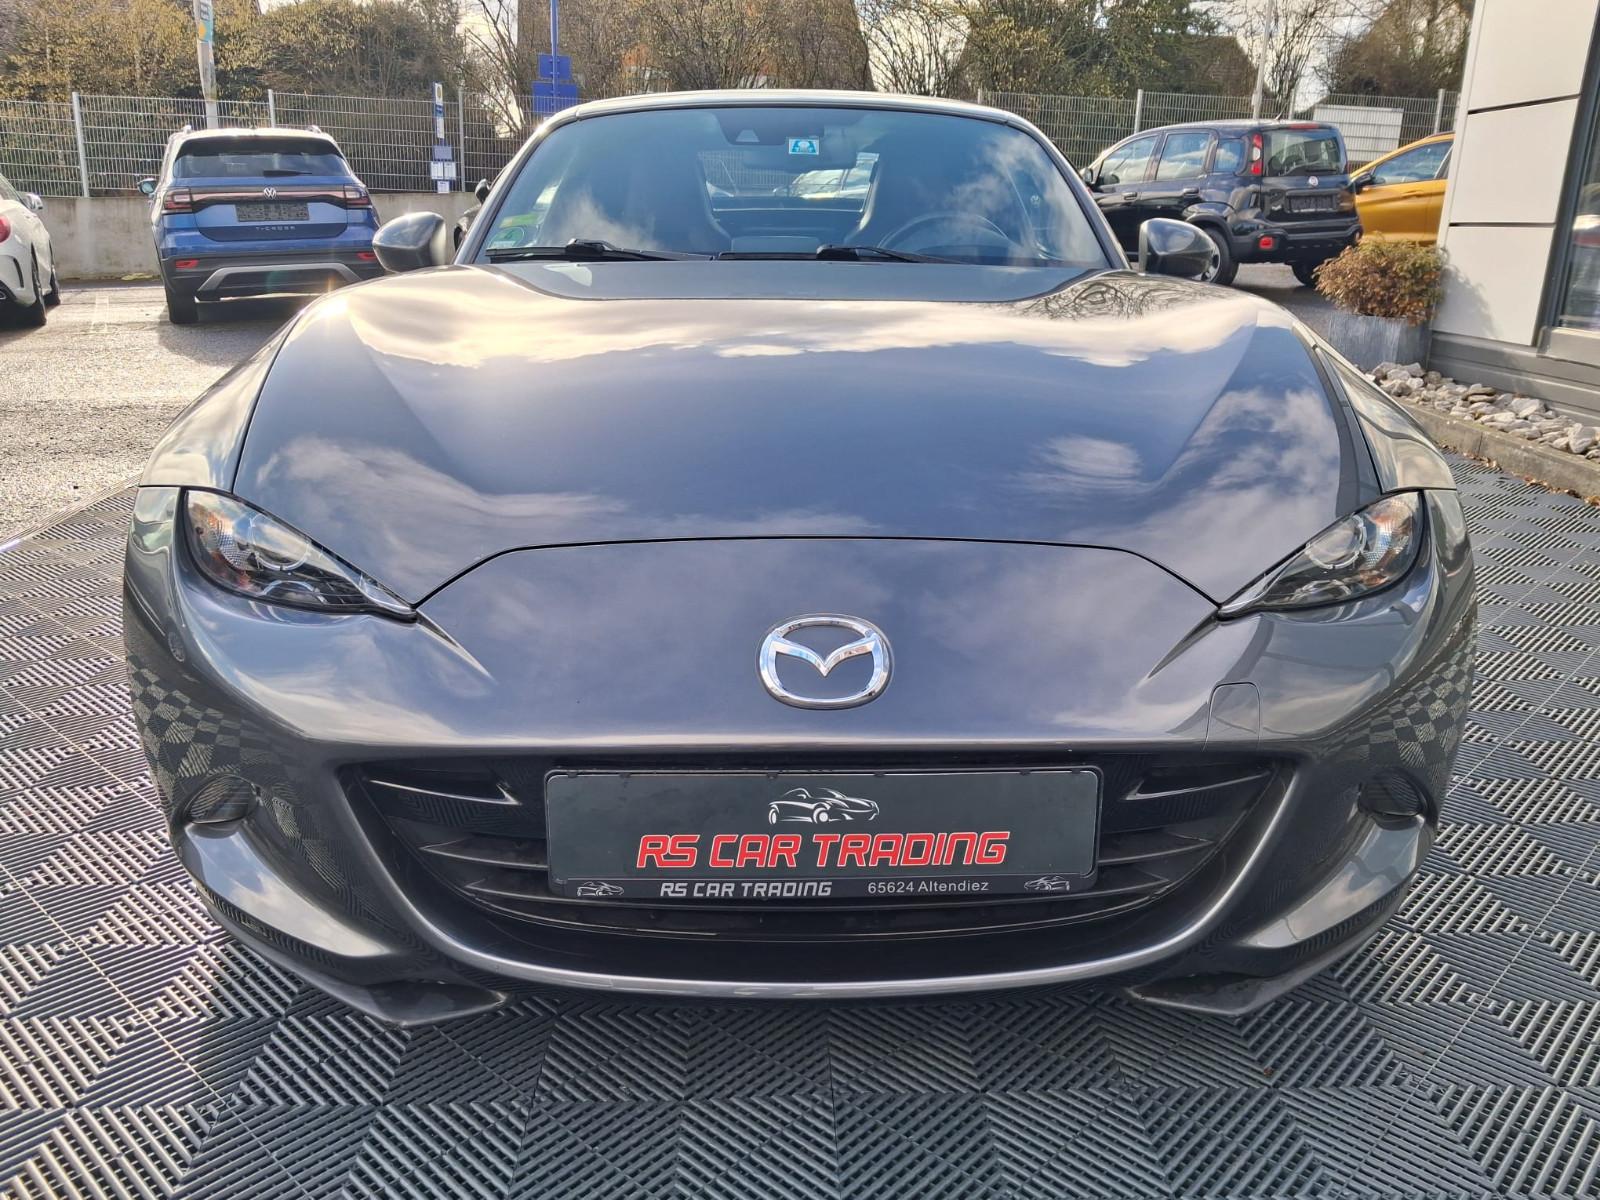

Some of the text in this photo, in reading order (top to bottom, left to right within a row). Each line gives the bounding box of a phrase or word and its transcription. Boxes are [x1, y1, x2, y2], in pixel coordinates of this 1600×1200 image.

[636, 831, 1010, 868] RS CAR TRADING
[660, 881, 833, 897] RS CAR TRADING
[867, 880, 990, 894] 65624 Altendiez
